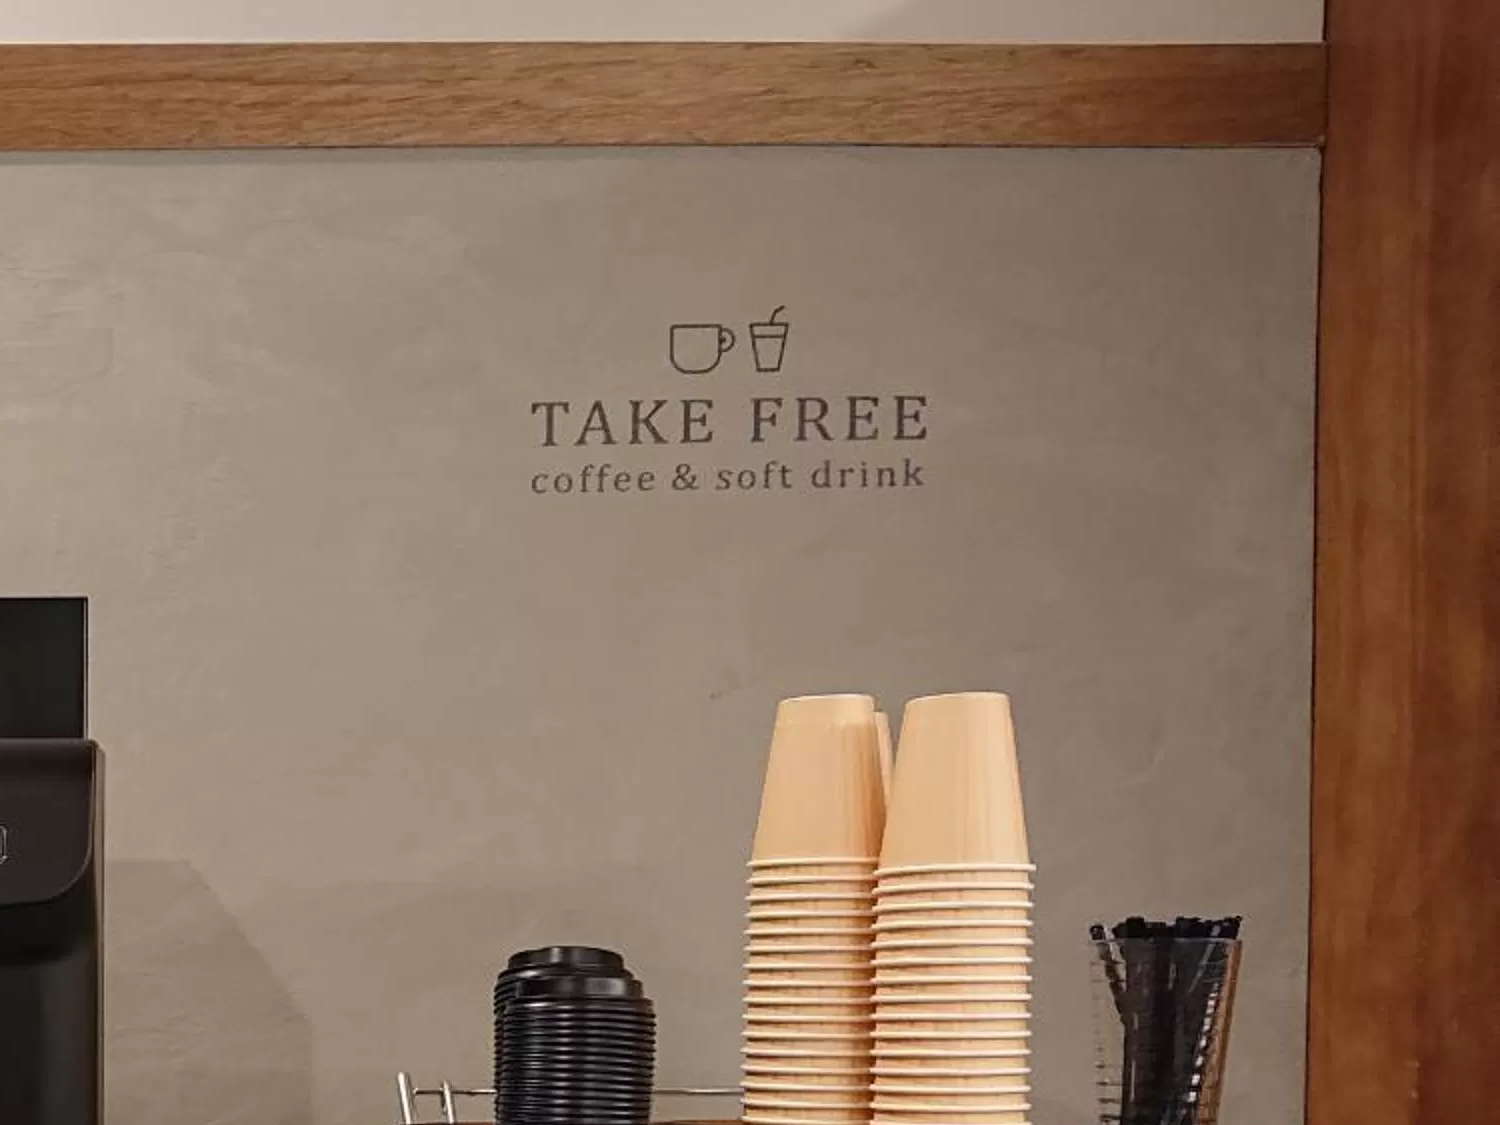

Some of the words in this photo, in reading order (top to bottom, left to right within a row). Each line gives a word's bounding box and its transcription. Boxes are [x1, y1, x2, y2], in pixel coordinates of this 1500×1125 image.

[531, 399, 714, 446] TAKE
[749, 395, 928, 443] FREE
[531, 463, 655, 494] coffee
[671, 462, 699, 491] &
[715, 460, 793, 490] soft
[810, 458, 925, 489] drink
